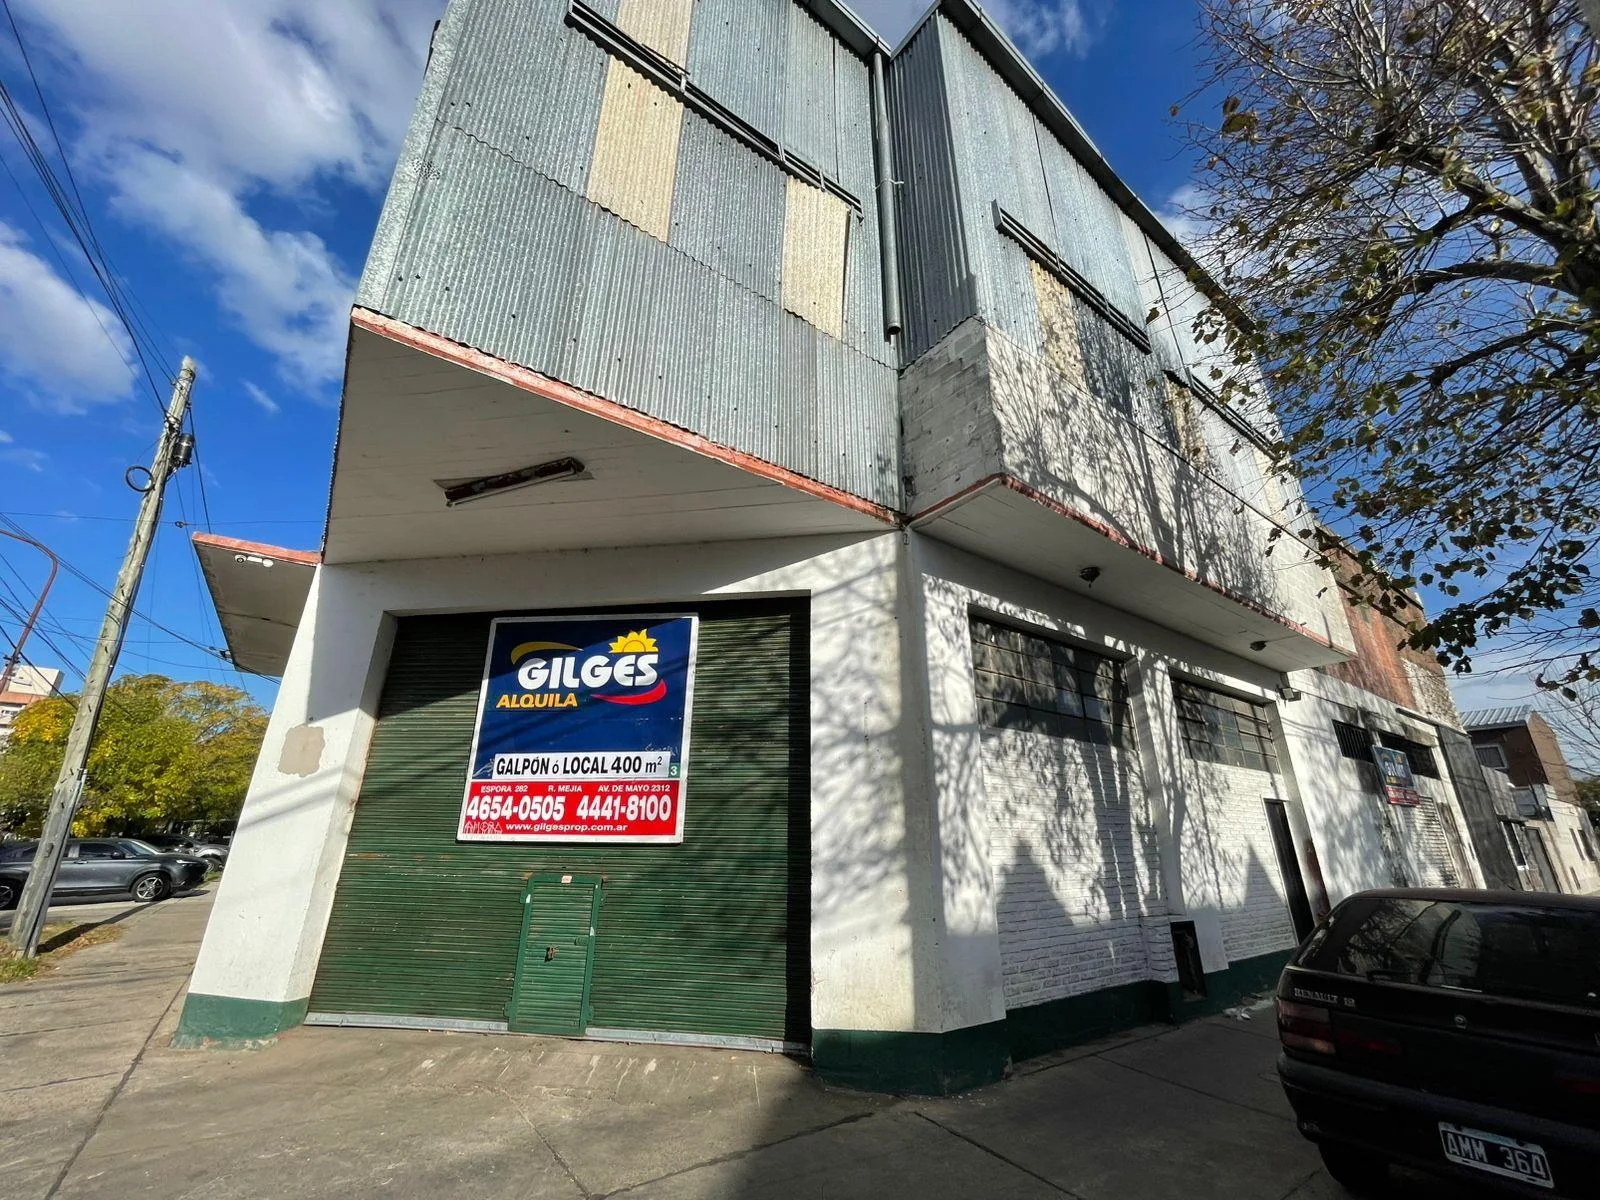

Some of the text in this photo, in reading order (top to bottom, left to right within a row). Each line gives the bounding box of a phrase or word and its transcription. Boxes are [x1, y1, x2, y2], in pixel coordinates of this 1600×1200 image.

[517, 654, 659, 690] GILGES
[496, 692, 578, 709] ALQUILA
[496, 756, 550, 775] GALPÓN
[552, 760, 559, 774] ó
[562, 756, 608, 775] LOCAL
[611, 756, 642, 774] 400
[670, 765, 678, 776] 3
[480, 785, 528, 793] ESPORA 282
[557, 785, 582, 793] MEJIA
[597, 784, 670, 792] AV. DE MAYO 2312
[466, 795, 566, 821] 4654-0505
[576, 794, 672, 821] 4441-8100
[506, 823, 628, 832] www.gilgesprop.com.ar
[1293, 987, 1339, 1004] RENAULT
[1446, 1132, 1547, 1178] AMM 364
